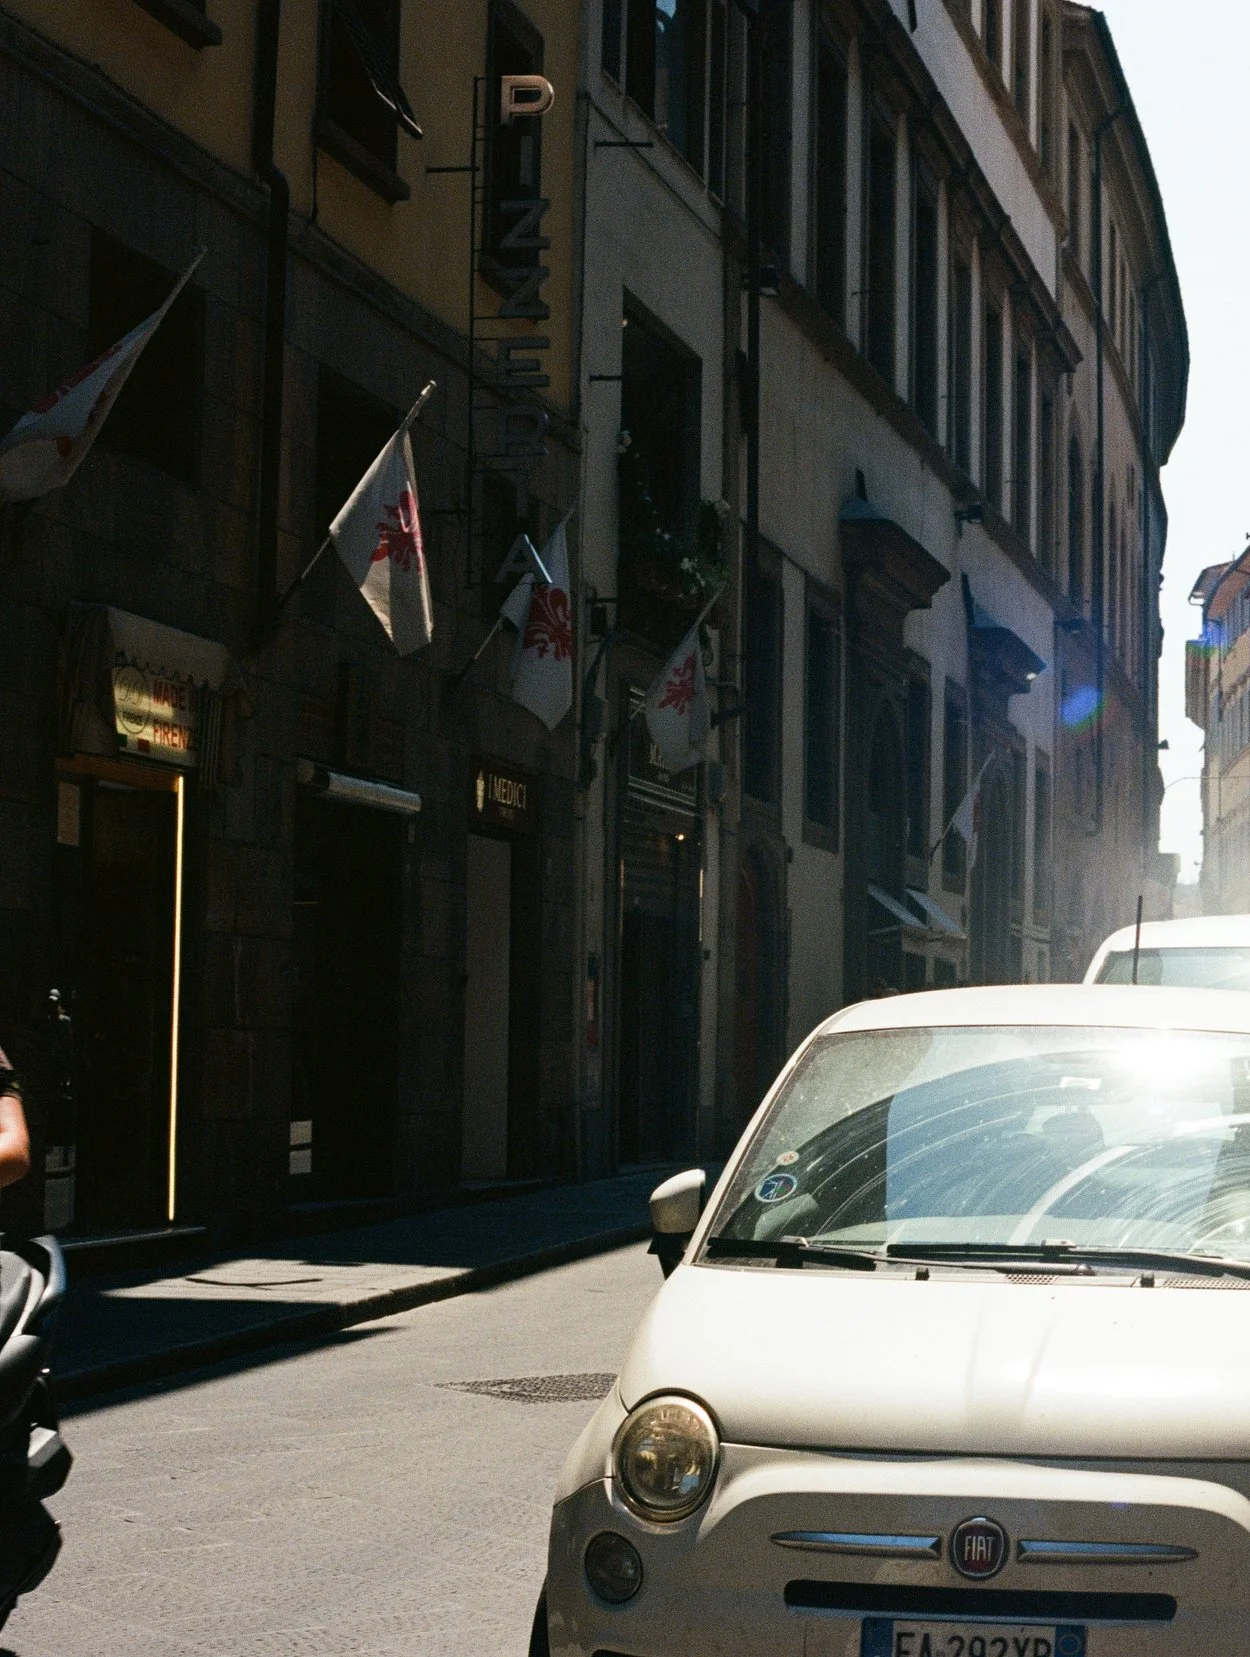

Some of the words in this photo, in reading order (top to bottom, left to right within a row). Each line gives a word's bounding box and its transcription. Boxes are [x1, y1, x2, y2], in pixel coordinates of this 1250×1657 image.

[494, 74, 554, 584] PIZZERIA
[152, 679, 186, 711] MADE
[493, 775, 527, 809] MEDICI
[963, 1535, 996, 1561] FIAT
